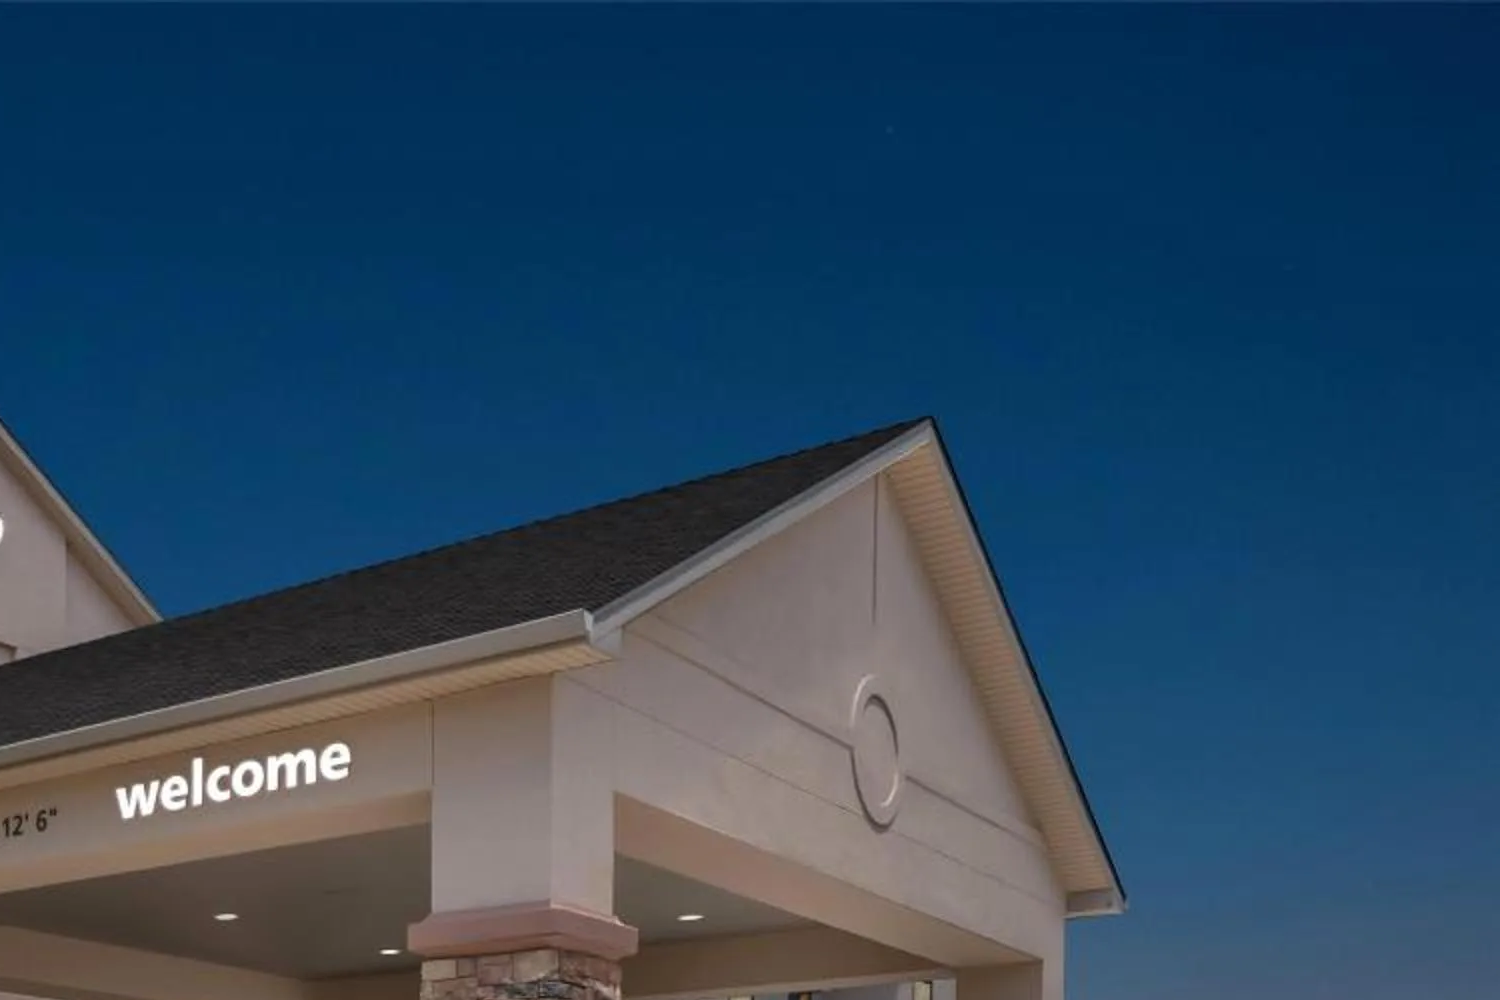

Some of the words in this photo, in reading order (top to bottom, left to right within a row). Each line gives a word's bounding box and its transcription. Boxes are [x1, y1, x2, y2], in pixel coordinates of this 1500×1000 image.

[115, 742, 352, 820] welcome
[2, 812, 30, 838] 12'
[35, 807, 58, 832] 6"
